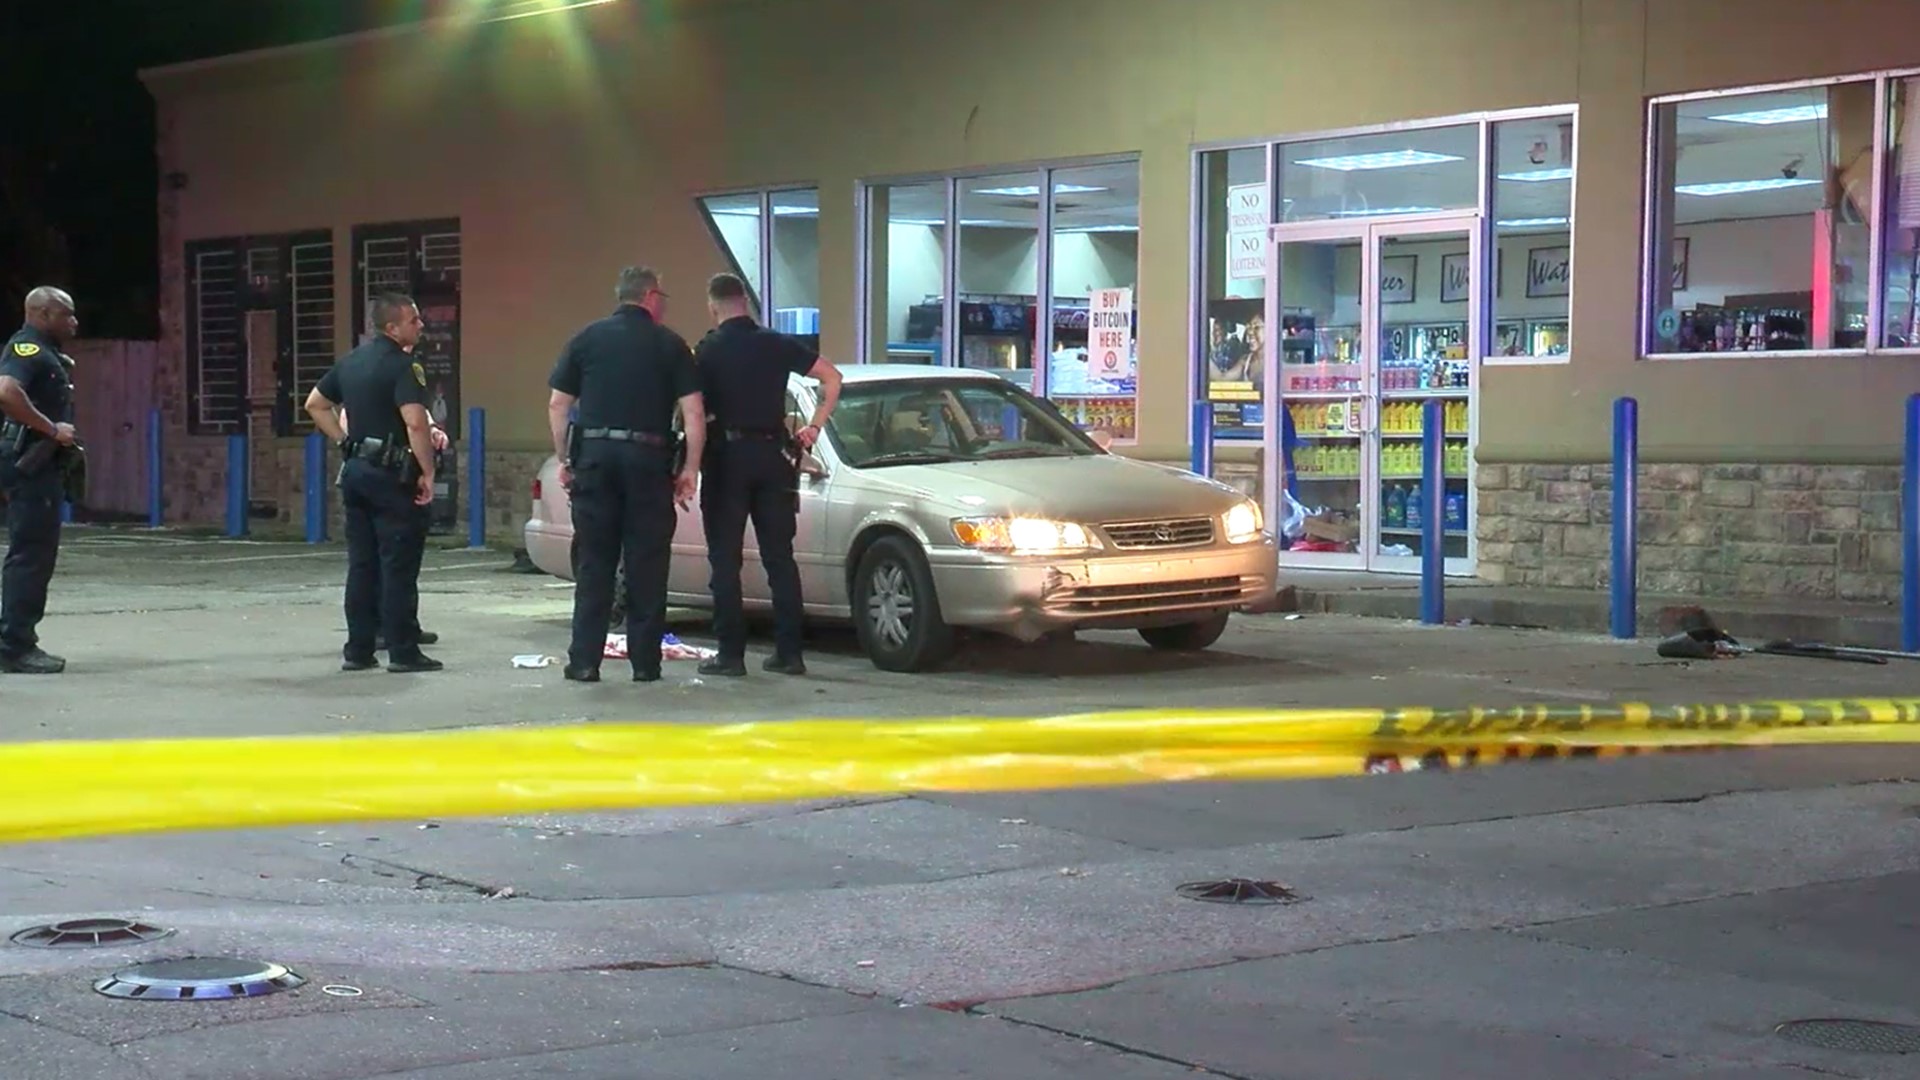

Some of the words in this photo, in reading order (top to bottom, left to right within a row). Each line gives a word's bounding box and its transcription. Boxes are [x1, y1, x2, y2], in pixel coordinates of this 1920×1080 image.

[1240, 193, 1260, 208] NO
[1240, 237, 1260, 252] NO
[1532, 258, 1570, 285] Wat
[1382, 276, 1406, 291] eer
[1102, 292, 1120, 308] BUY
[1093, 311, 1129, 328] BITCOIN
[1100, 332, 1122, 348] HERE
